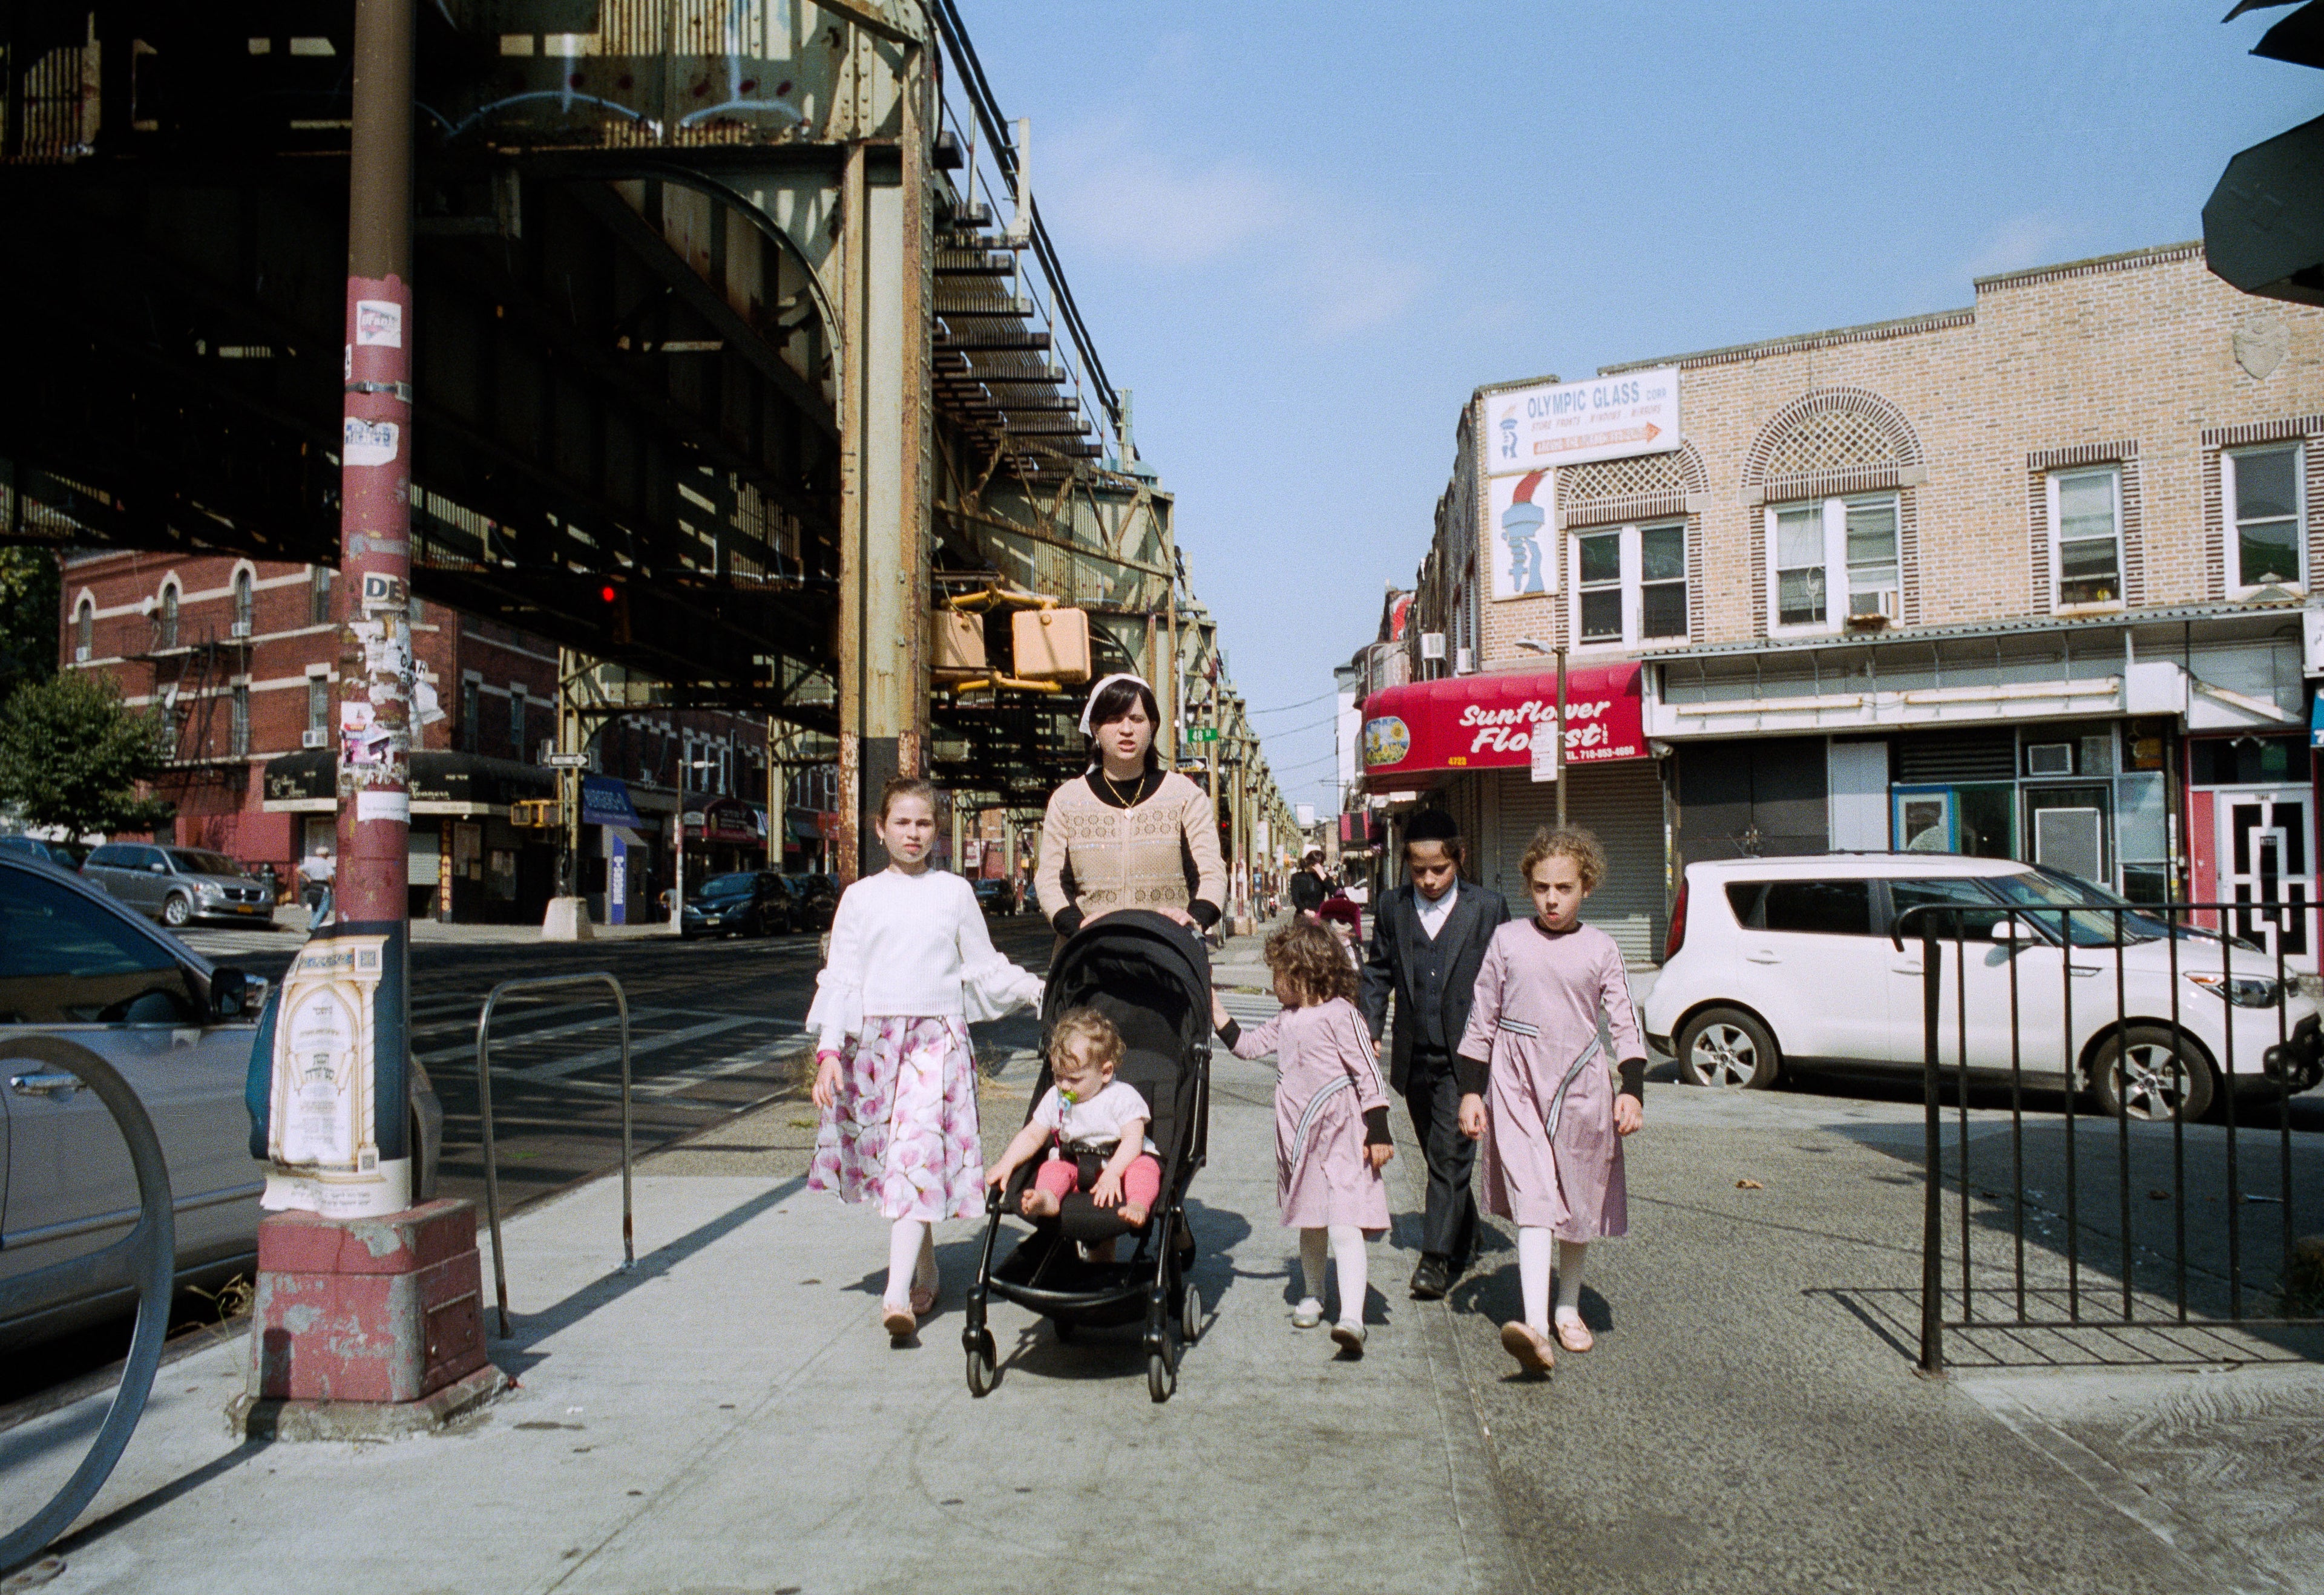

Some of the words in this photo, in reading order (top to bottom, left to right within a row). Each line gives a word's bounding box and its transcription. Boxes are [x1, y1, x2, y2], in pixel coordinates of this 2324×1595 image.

[1528, 389, 1586, 418] OLYMPIC
[1592, 381, 1641, 408] GLASS
[1192, 729, 1203, 741] 48
